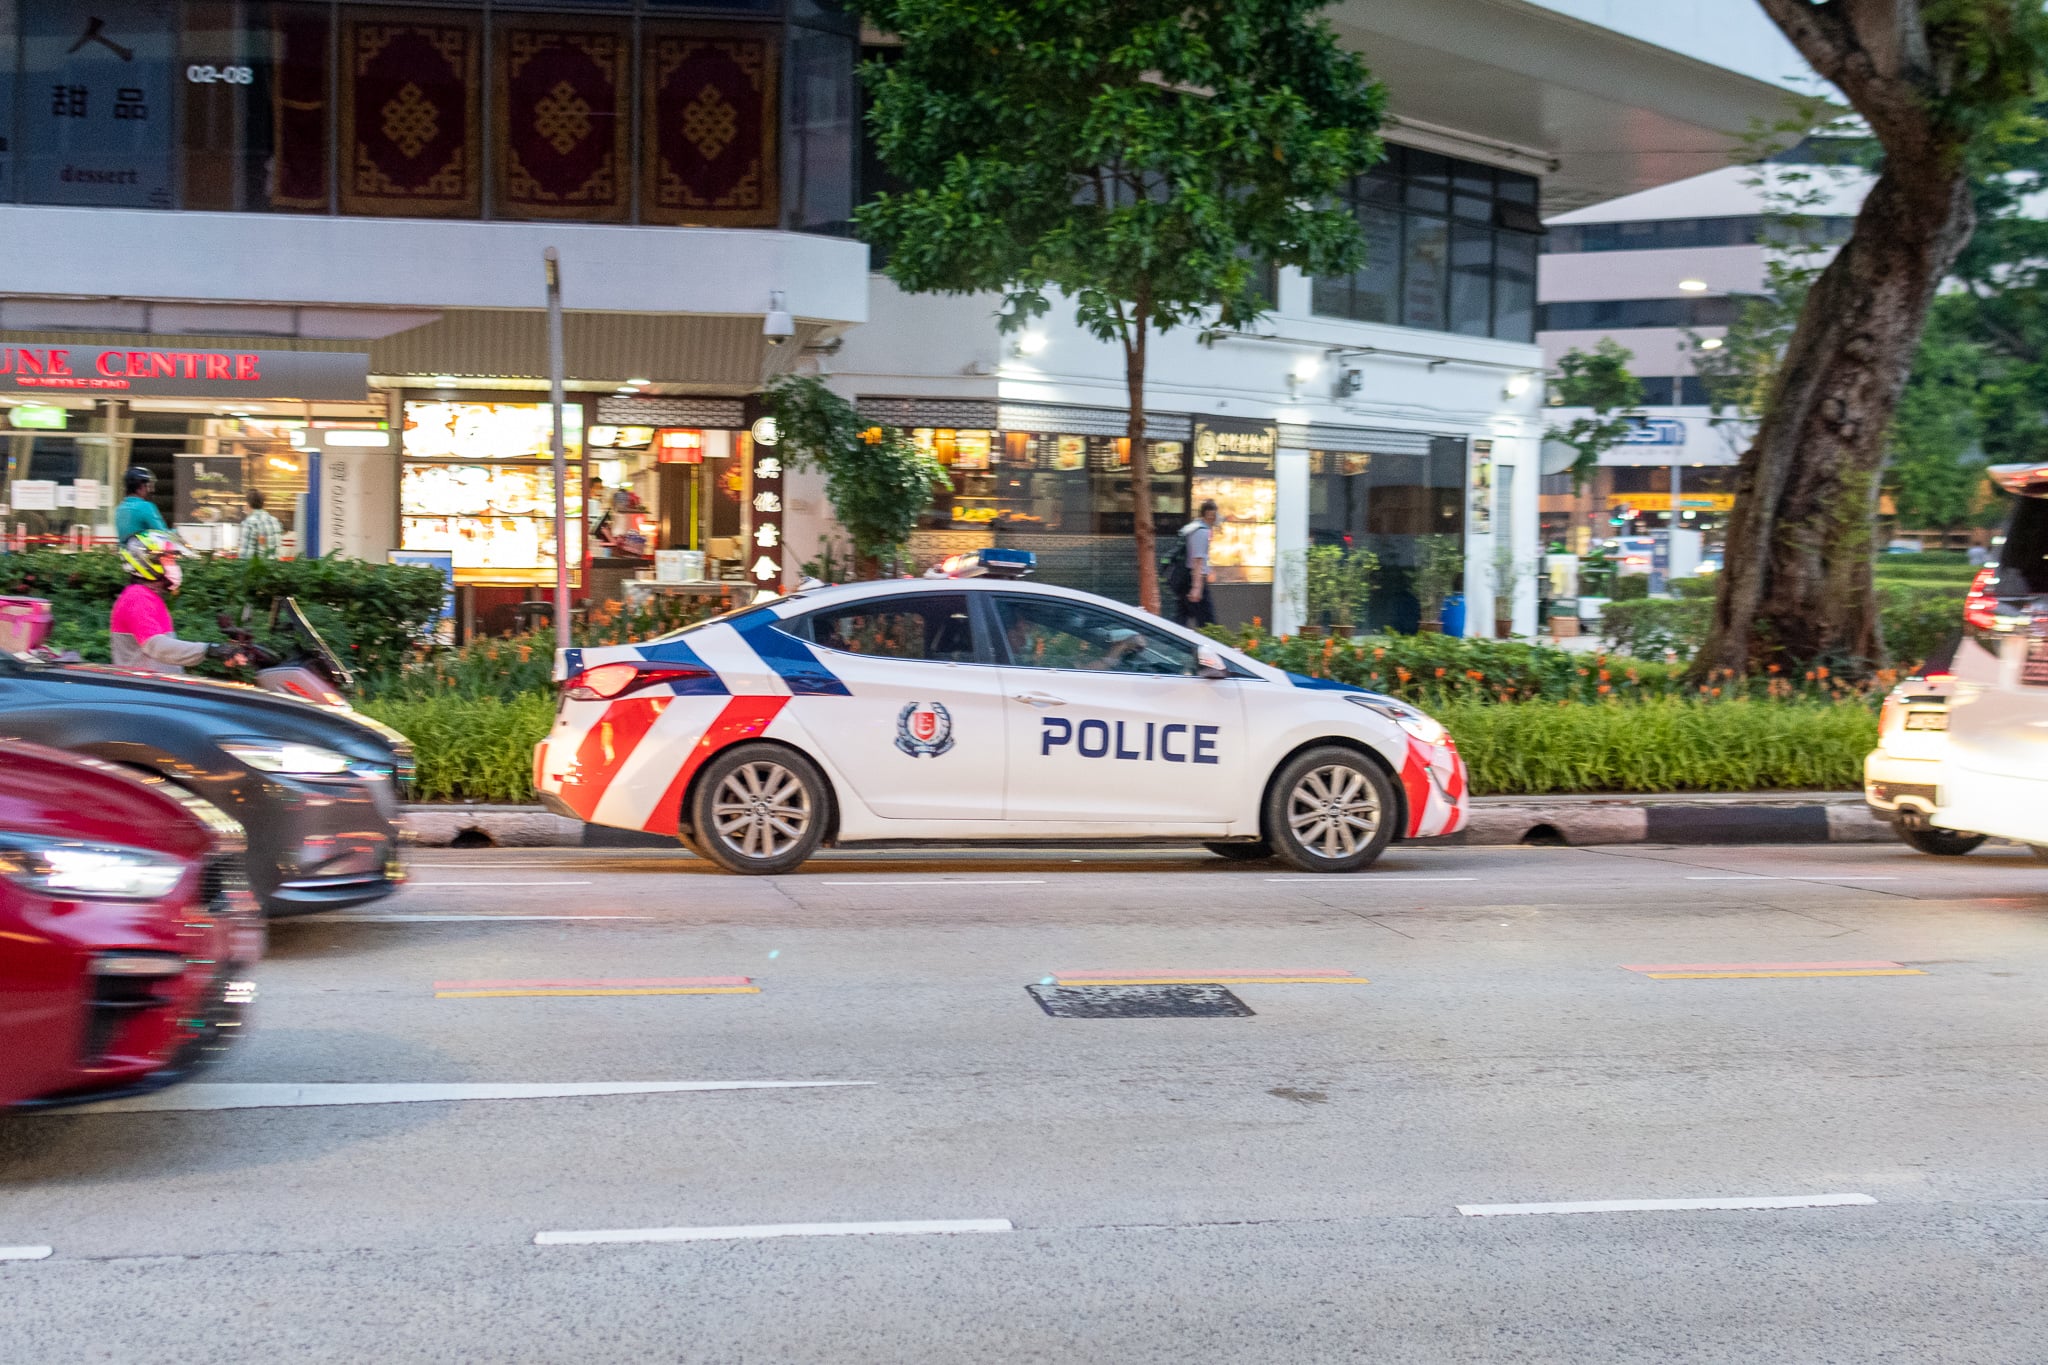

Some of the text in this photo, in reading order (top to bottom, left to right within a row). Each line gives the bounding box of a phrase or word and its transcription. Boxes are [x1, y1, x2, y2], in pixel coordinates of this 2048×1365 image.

[187, 65, 253, 84] 02-08
[52, 85, 147, 120] 甜品
[60, 164, 138, 185] dessert
[96, 351, 260, 381] CENTRE
[1041, 717, 1220, 764] POLICE
